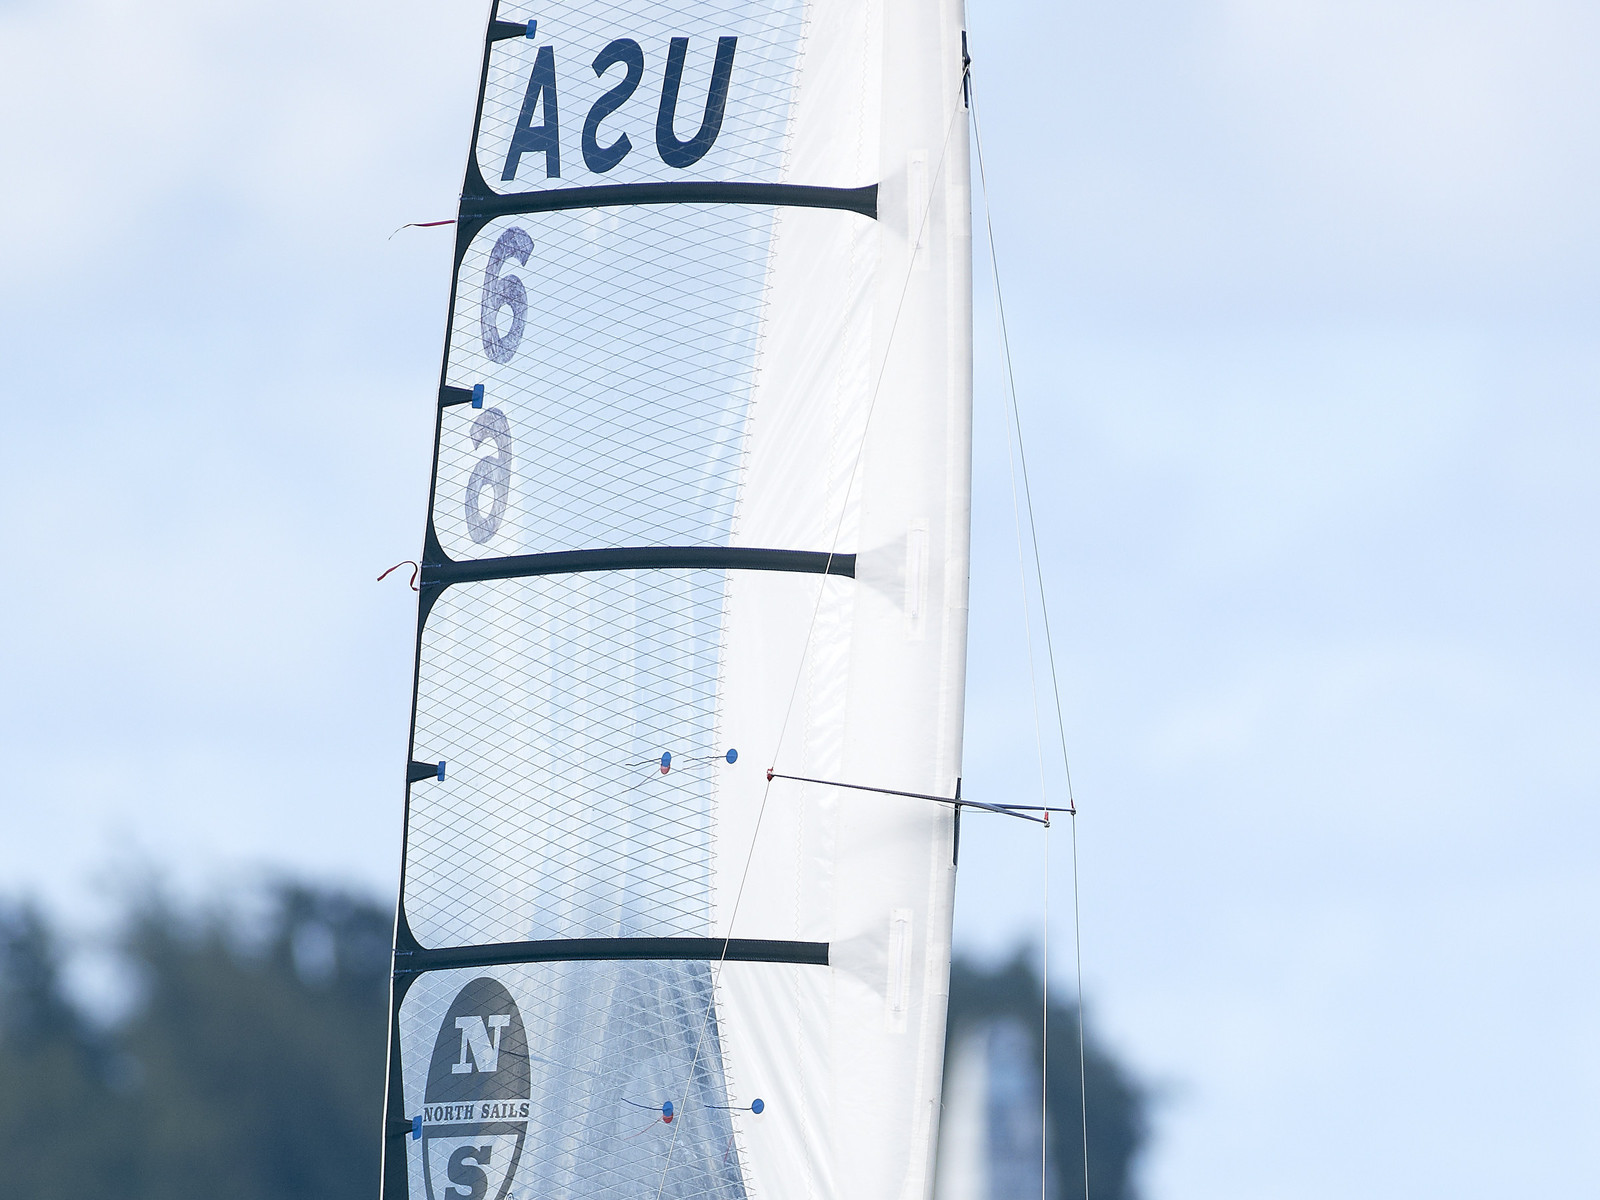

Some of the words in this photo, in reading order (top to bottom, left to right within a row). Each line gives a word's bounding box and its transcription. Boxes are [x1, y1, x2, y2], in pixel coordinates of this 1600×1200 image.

[480, 226, 535, 364] 6
[451, 1014, 511, 1074] N
[424, 1104, 474, 1122] NORTH
[481, 1102, 530, 1119] SAILS
